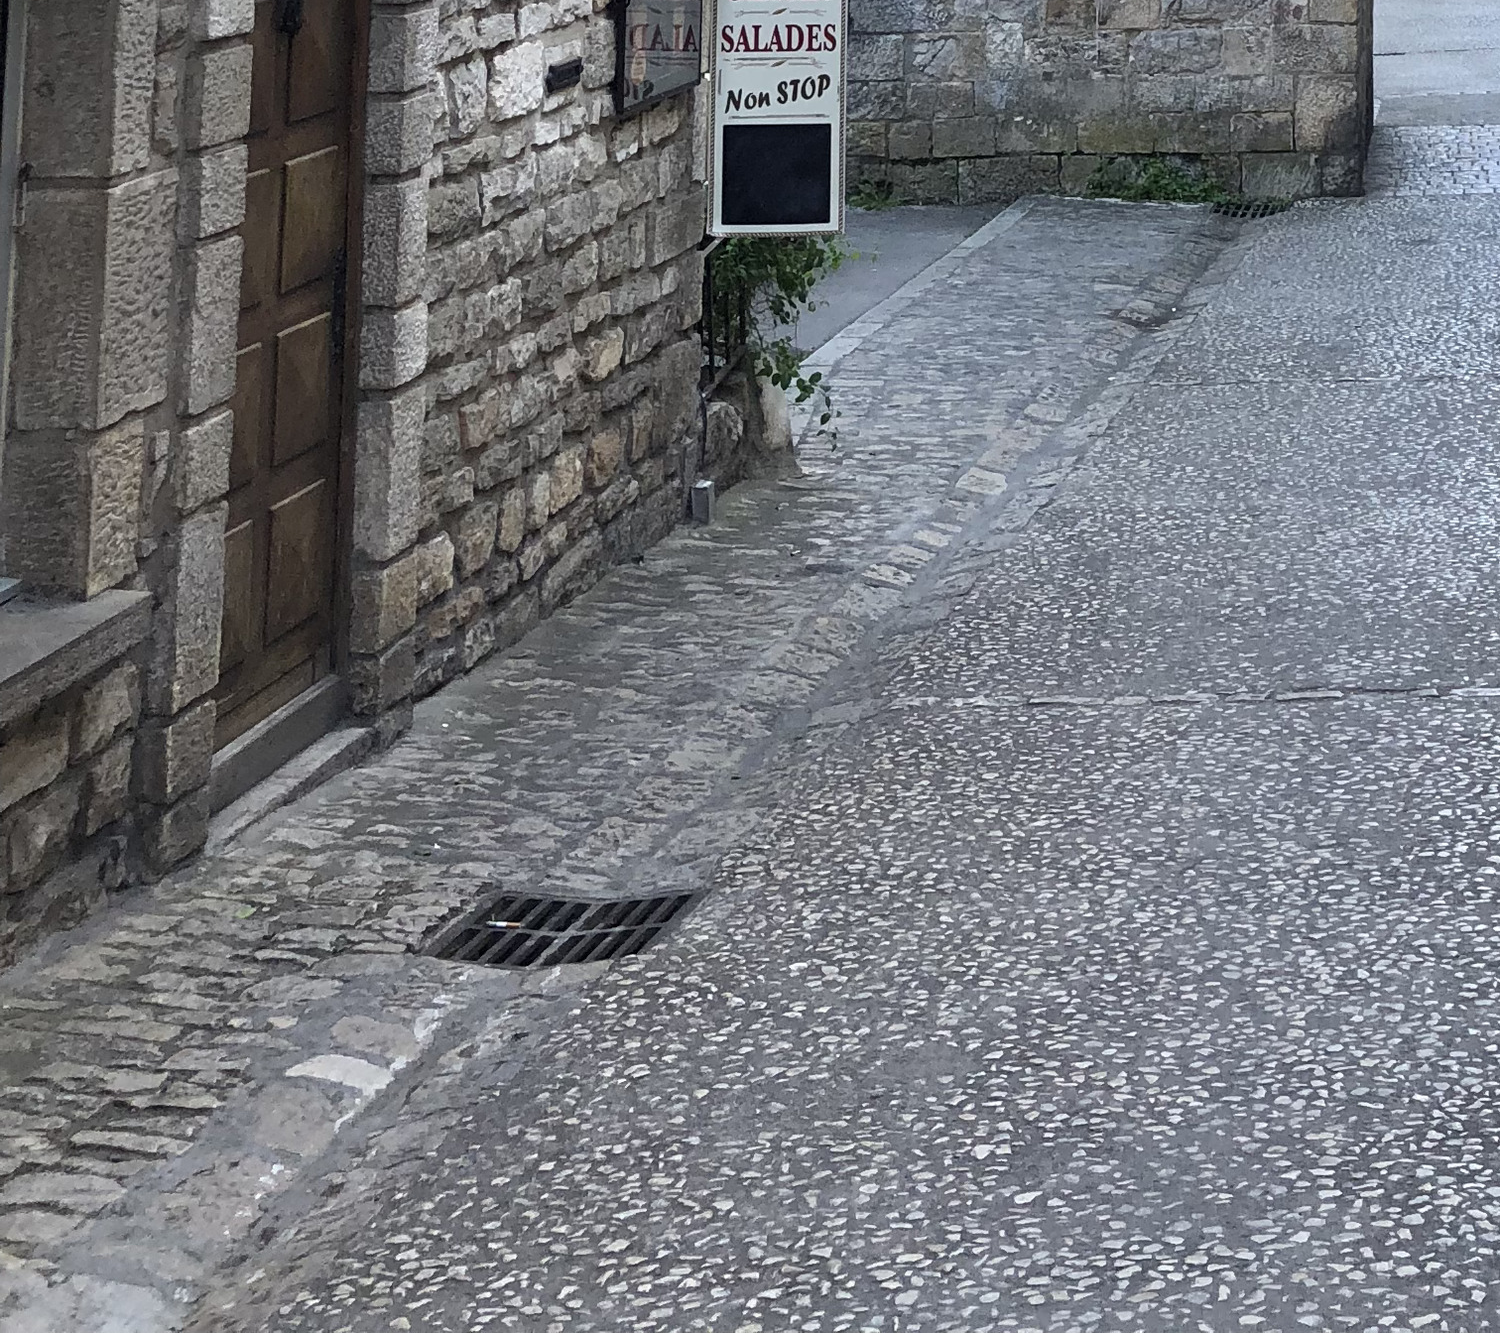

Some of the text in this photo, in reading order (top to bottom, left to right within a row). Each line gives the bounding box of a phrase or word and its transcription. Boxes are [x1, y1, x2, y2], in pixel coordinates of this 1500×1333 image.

[720, 24, 837, 53] SALADES
[725, 73, 831, 114] Non STOP
